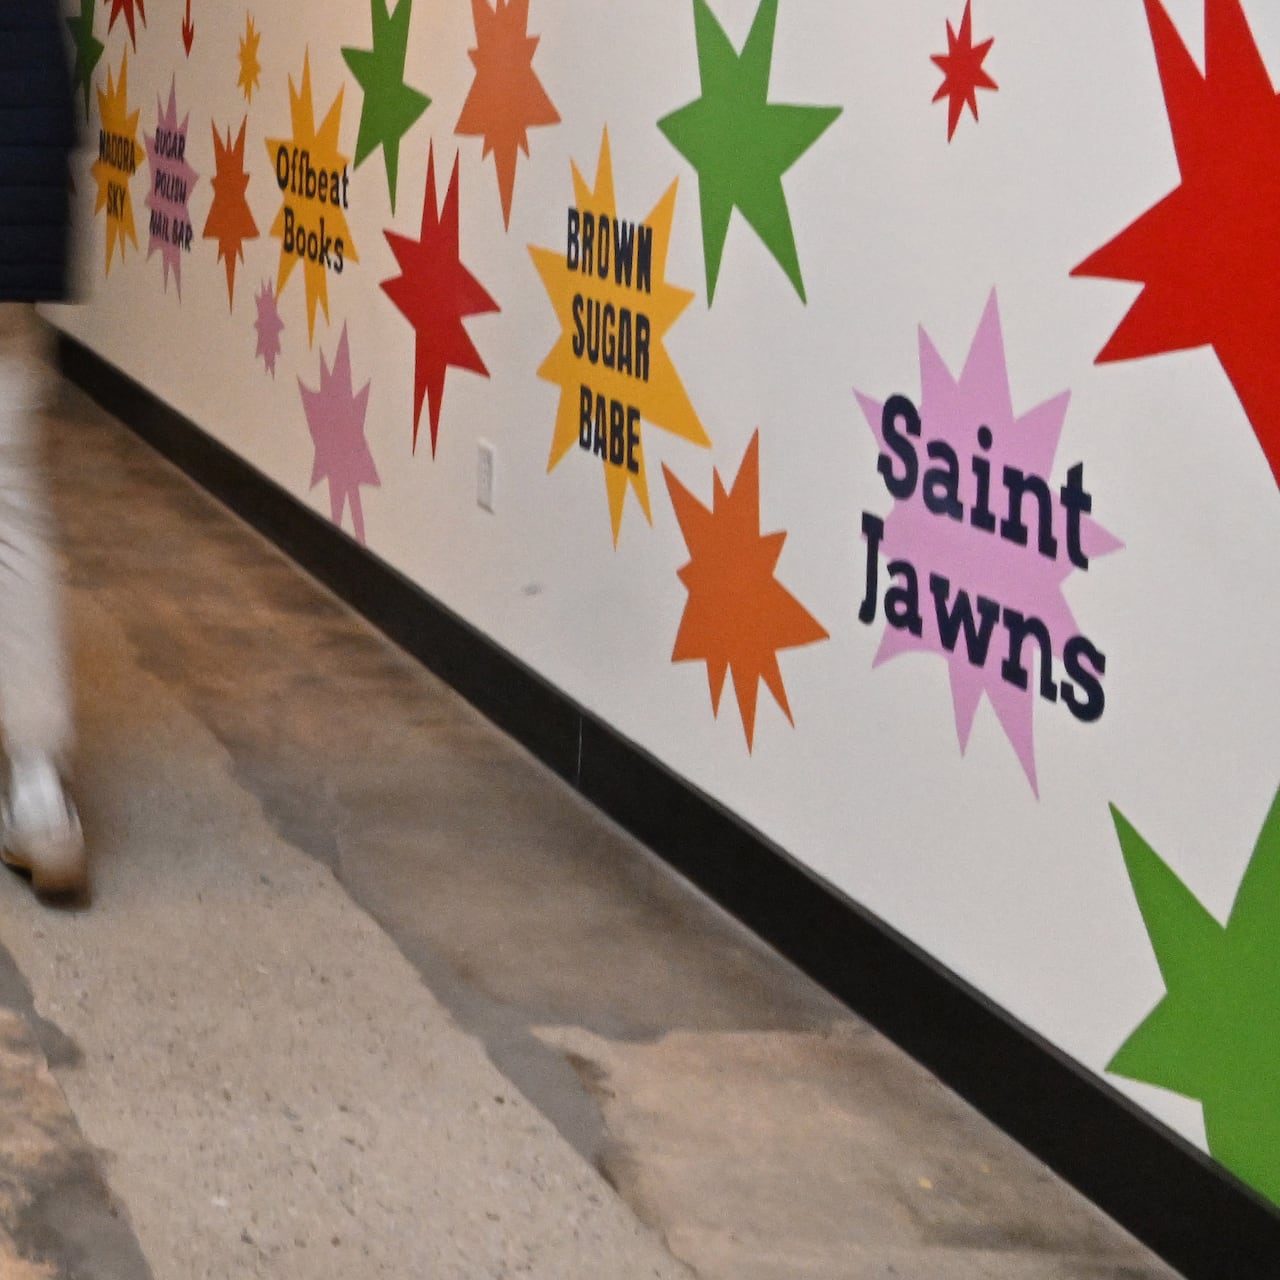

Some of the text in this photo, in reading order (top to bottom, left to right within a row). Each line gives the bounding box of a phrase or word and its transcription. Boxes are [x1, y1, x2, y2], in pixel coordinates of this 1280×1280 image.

[155, 127, 185, 164] SUGAR
[277, 144, 349, 209] Offbeat
[107, 180, 127, 222] SKY
[154, 168, 187, 205] POLISH
[149, 209, 193, 253] NAIL BAR
[284, 207, 344, 274] Books
[567, 206, 653, 295] BROWN
[572, 293, 651, 383] SUGAR
[579, 383, 640, 475] BABE
[877, 394, 1092, 571] Saint
[858, 511, 1106, 724] Jawns
